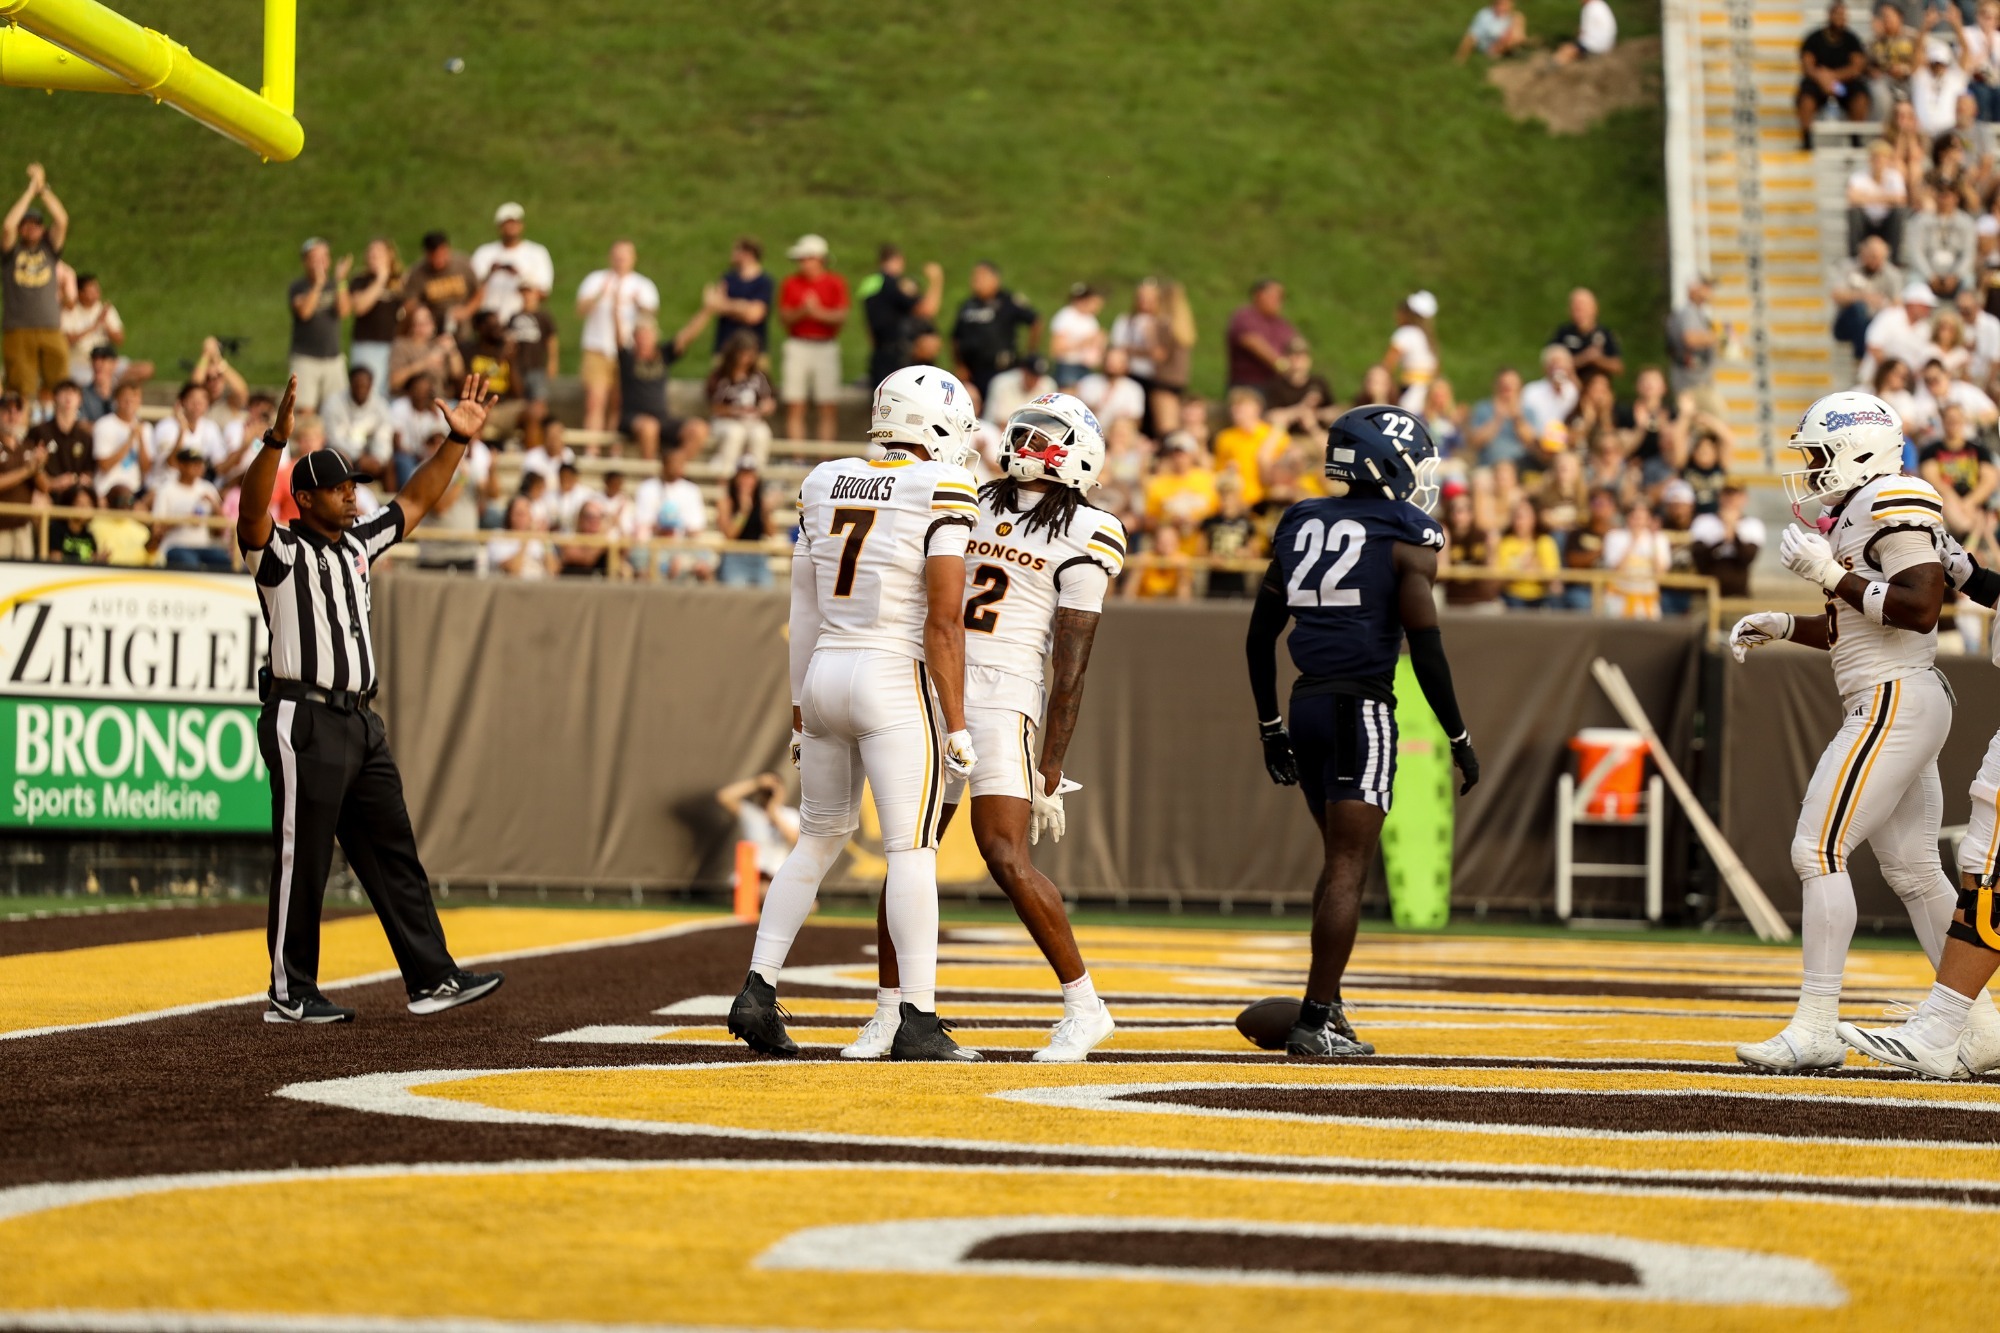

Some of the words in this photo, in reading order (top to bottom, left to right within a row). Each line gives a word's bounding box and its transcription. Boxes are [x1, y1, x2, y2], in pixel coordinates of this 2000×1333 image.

[940, 380, 956, 406] 7
[1382, 412, 1415, 441] 22
[830, 475, 896, 501] BROOKS
[829, 506, 877, 598] 7
[965, 539, 1047, 571] RONCOS
[1287, 518, 1366, 606] 22
[90, 599, 138, 616] AUTO
[150, 600, 208, 618] GROUP
[963, 562, 1010, 637] 2
[15, 704, 267, 782] BRONSO
[13, 779, 96, 824] Sports
[103, 781, 221, 820] Medicine
